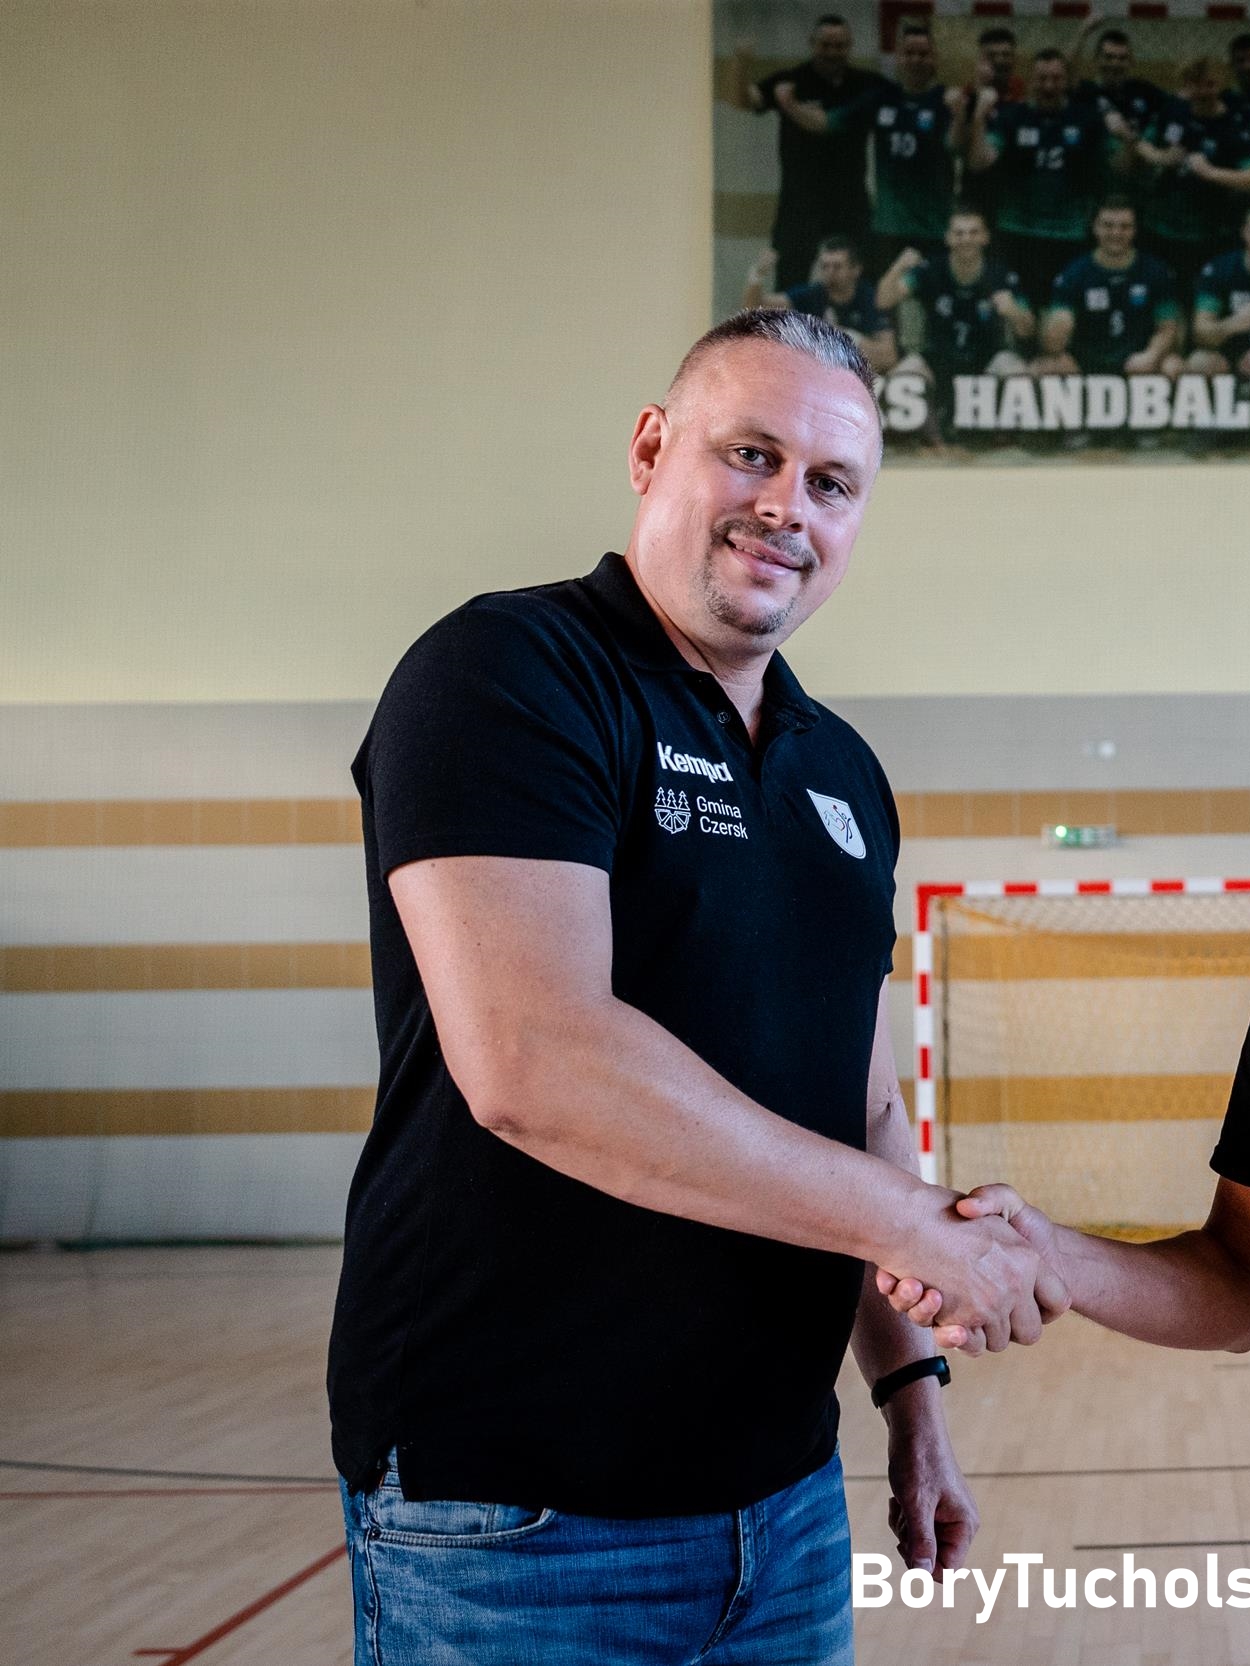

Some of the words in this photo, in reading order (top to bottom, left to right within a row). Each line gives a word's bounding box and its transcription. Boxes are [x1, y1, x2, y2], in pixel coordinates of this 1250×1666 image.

[890, 132, 917, 157] 10
[657, 741, 733, 783] Kempa
[696, 796, 742, 818] Gmina
[699, 815, 748, 840] Czersk
